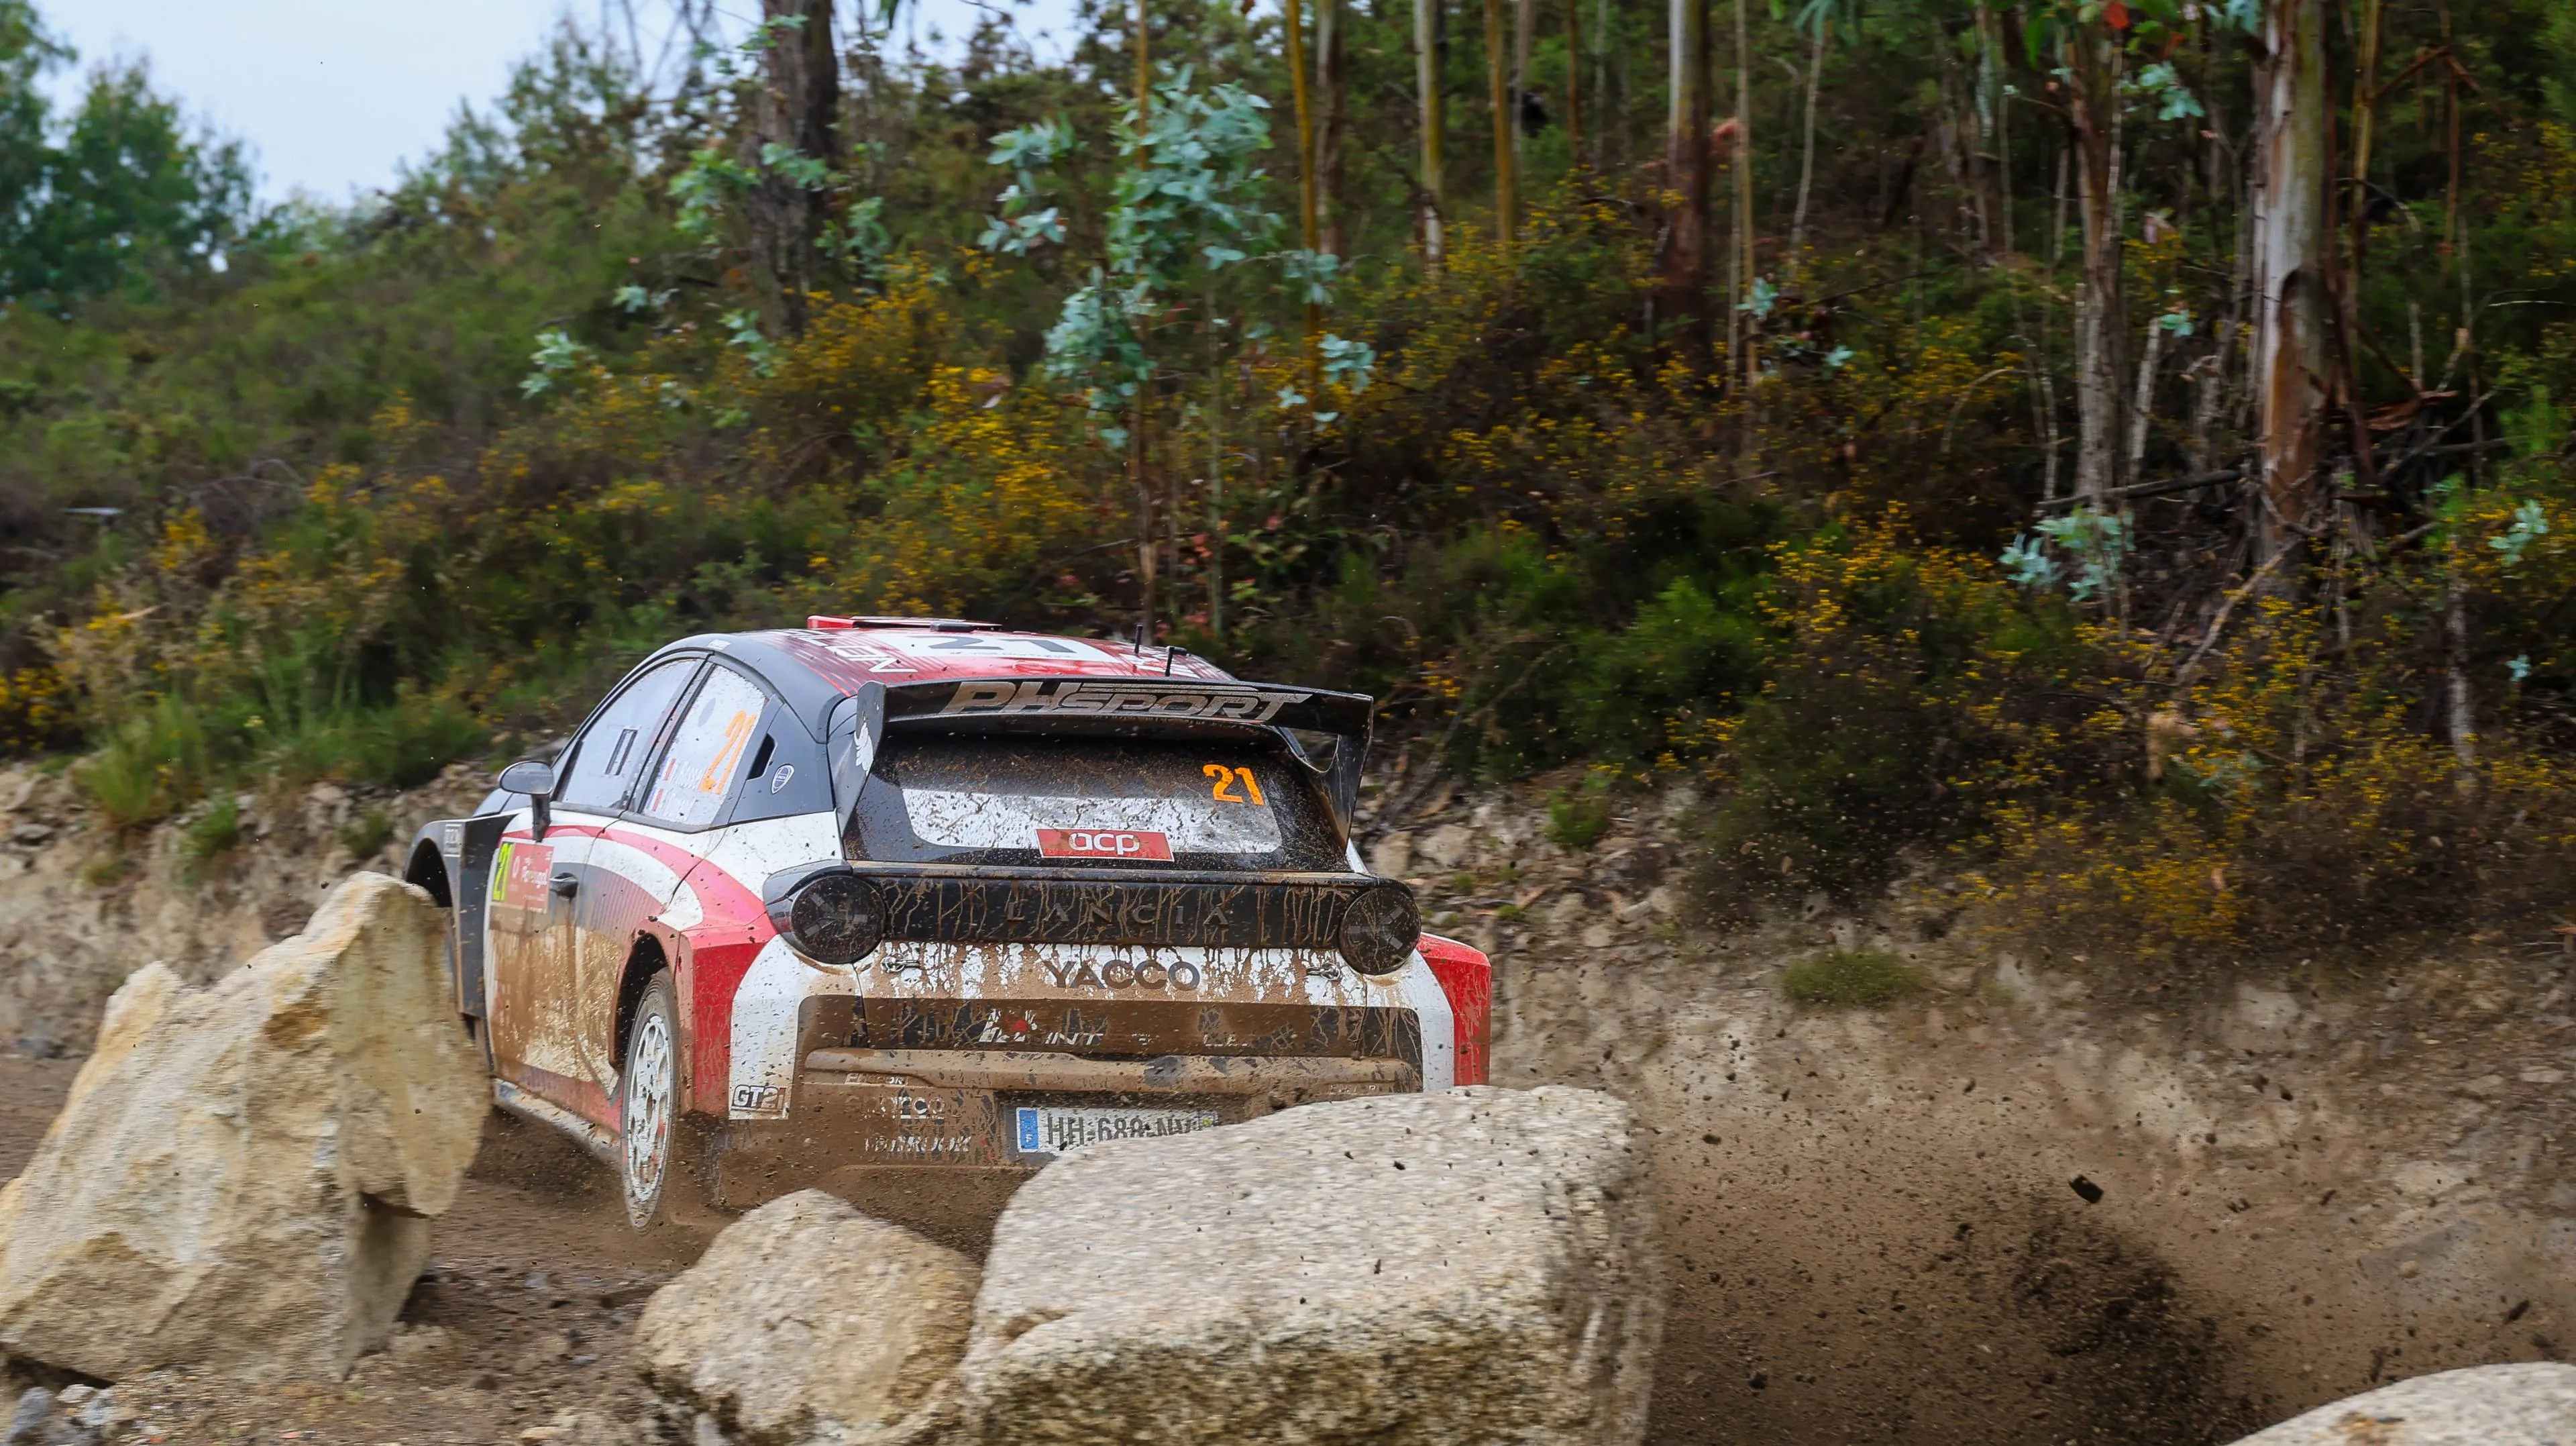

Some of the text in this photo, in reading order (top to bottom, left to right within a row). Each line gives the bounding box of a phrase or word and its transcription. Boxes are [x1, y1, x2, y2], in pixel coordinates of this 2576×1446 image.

[940, 682, 1313, 721] PHSPORT
[698, 710, 757, 795] 21
[1203, 764, 1265, 805] 21
[1069, 833, 1140, 856] acp
[493, 843, 514, 900] 21
[1006, 901, 1229, 925] LANCIA
[1042, 960, 1200, 990] YACCO
